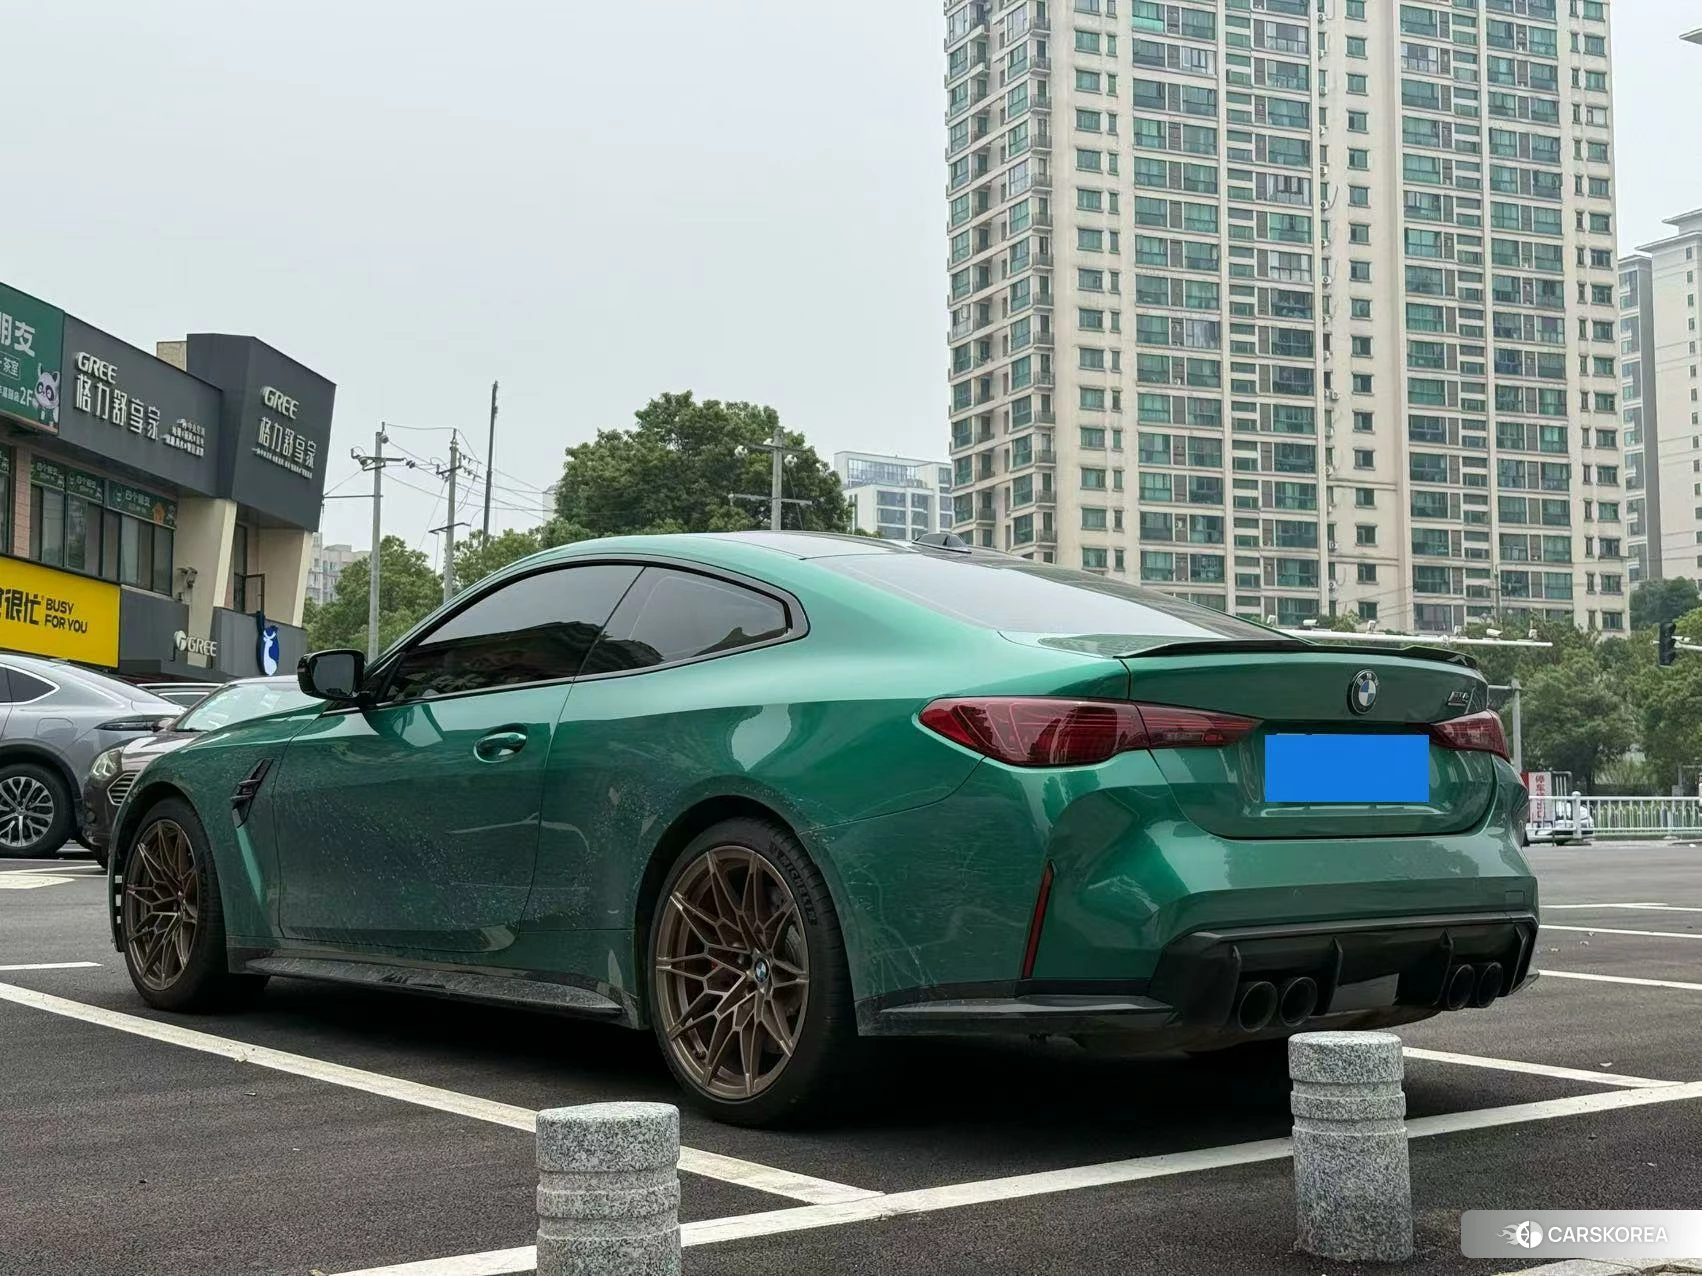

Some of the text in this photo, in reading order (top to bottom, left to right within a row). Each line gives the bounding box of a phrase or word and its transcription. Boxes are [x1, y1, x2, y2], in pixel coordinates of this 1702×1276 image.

[78, 351, 118, 384] GREE
[75, 373, 160, 441] 格力舒享家
[263, 386, 300, 420] GREE
[258, 416, 317, 469] 格力舒享家
[0, 587, 41, 626] 很忙
[45, 597, 75, 615] BUSY
[44, 613, 89, 634] FOR YOU
[187, 636, 218, 657] GREE
